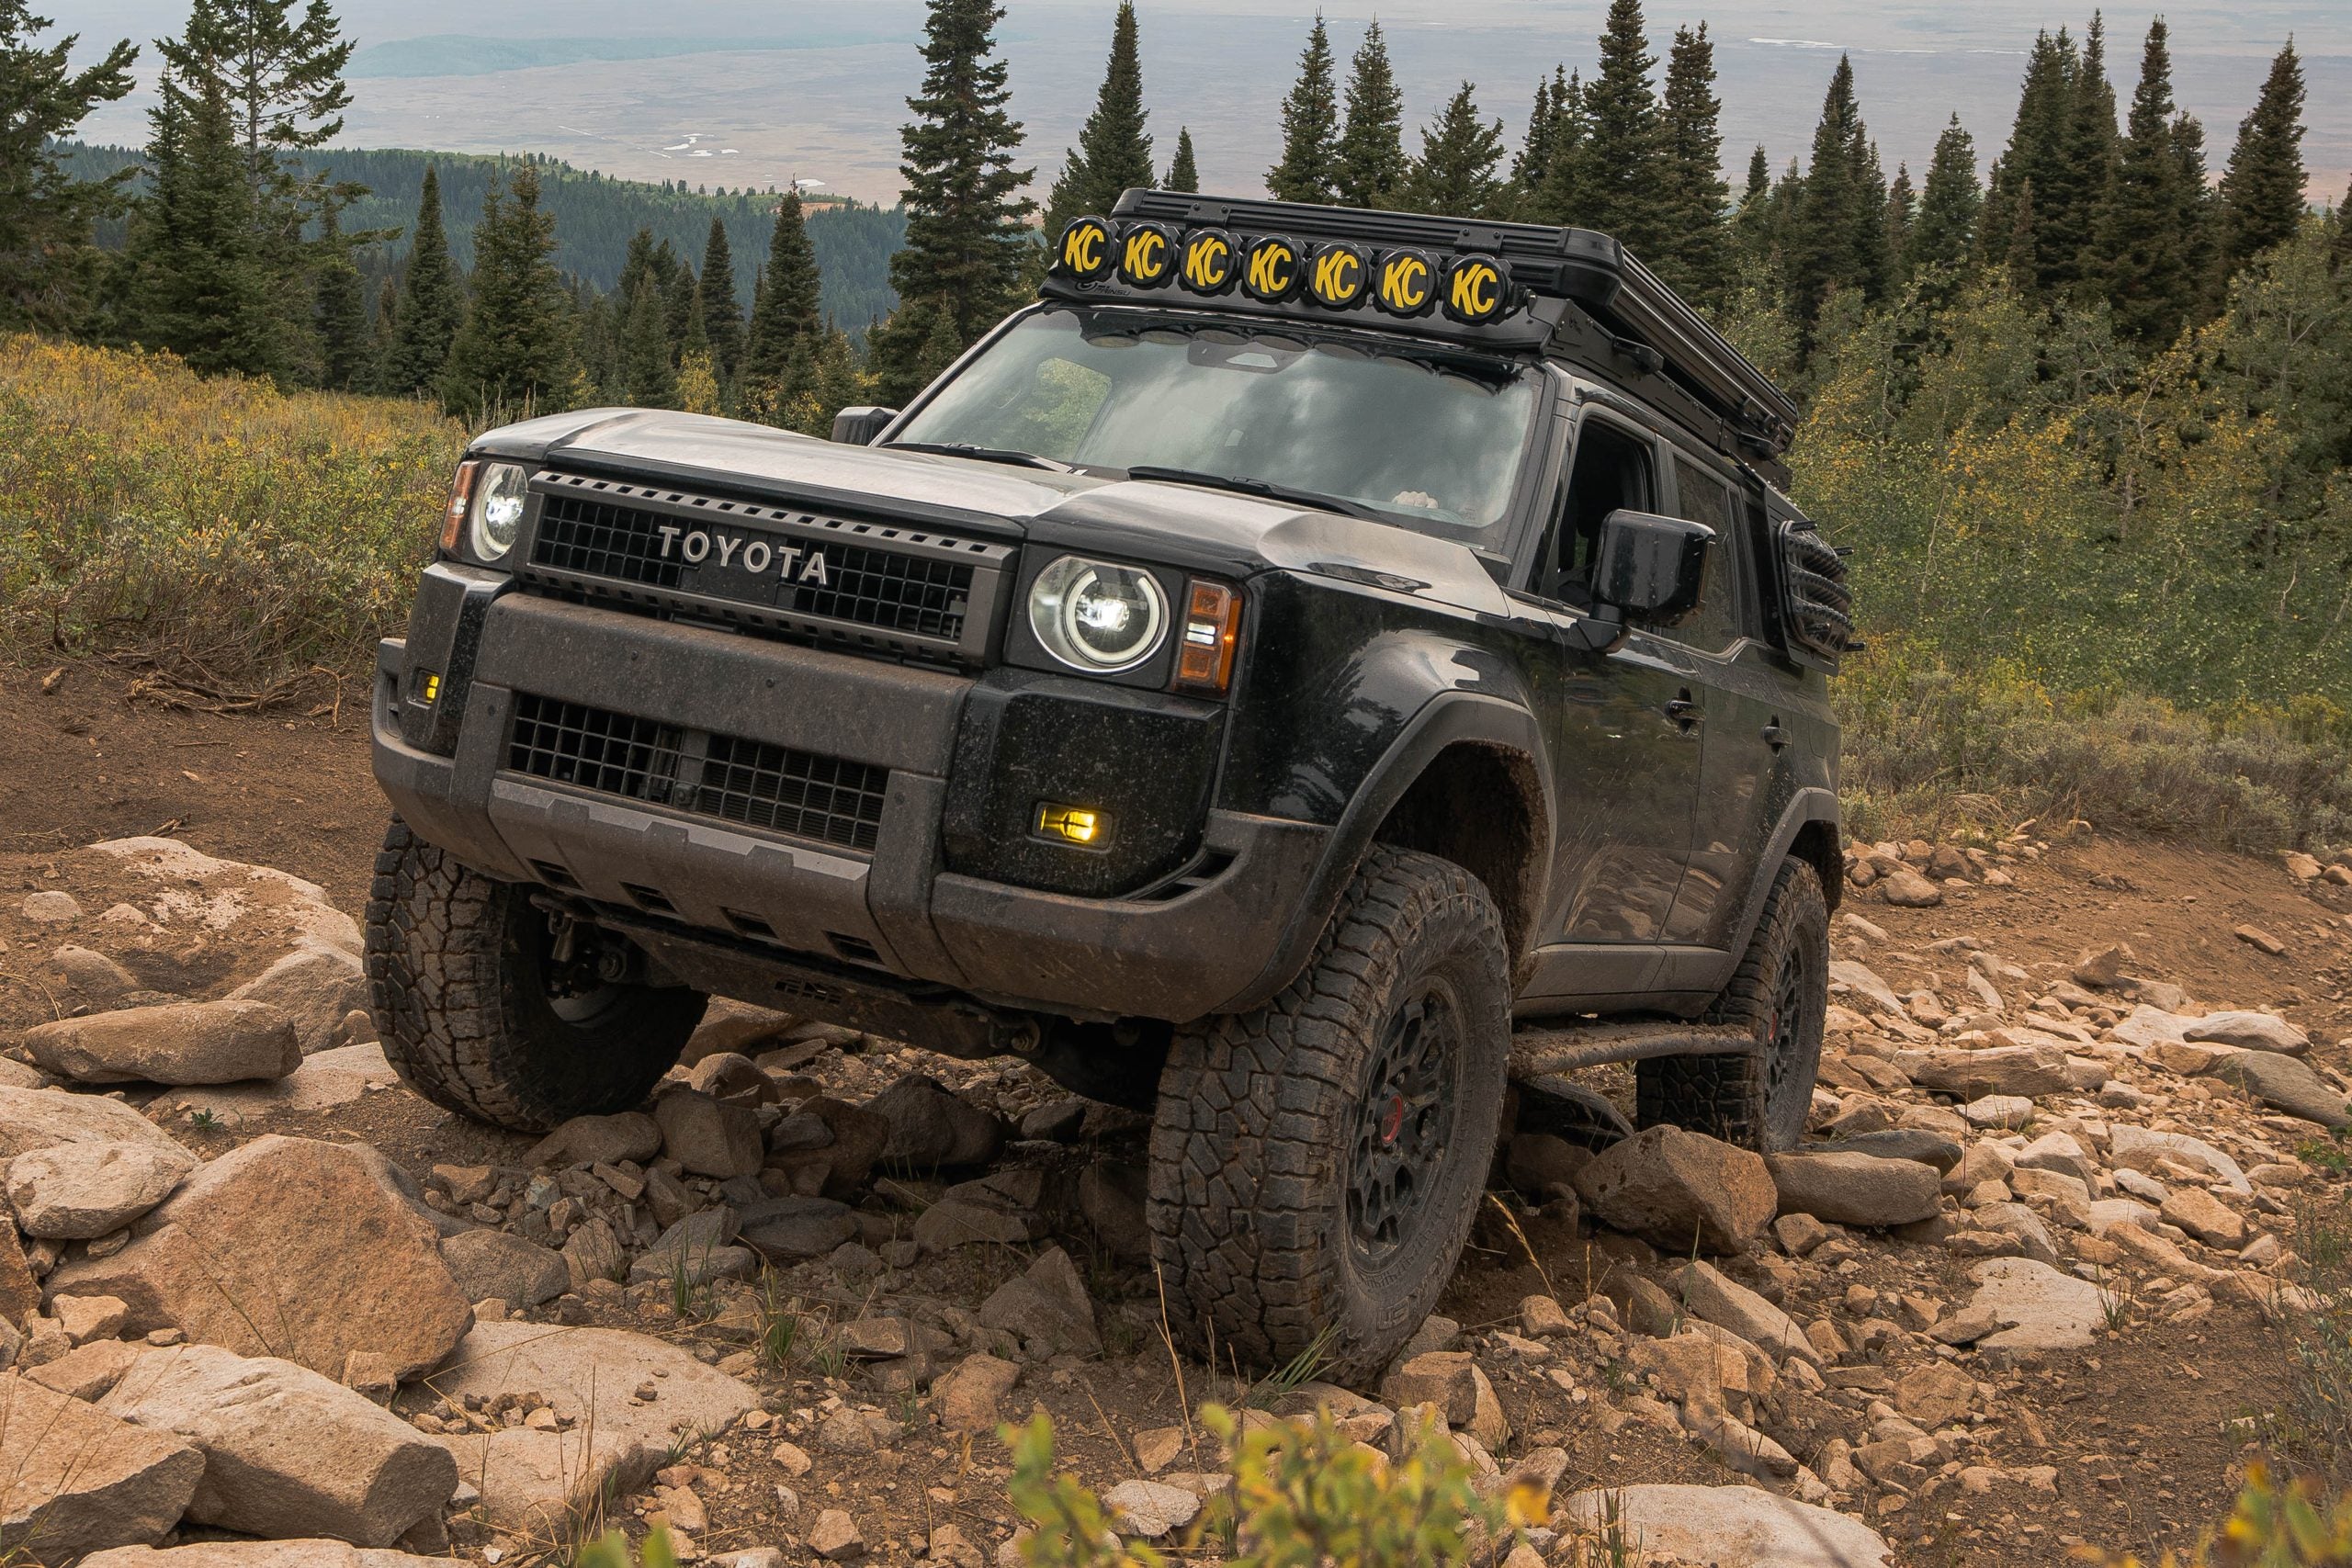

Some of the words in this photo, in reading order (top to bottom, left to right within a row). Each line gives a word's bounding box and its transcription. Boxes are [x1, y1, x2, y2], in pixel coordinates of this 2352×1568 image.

[1064, 224, 1104, 273] KC
[1124, 231, 1165, 278] KC
[1185, 237, 1227, 287] KC
[1249, 243, 1292, 294] KC
[1314, 250, 1359, 301] KC
[1382, 256, 1427, 309] KC
[1451, 264, 1498, 316] KC
[658, 525, 828, 585] TOYOTA
